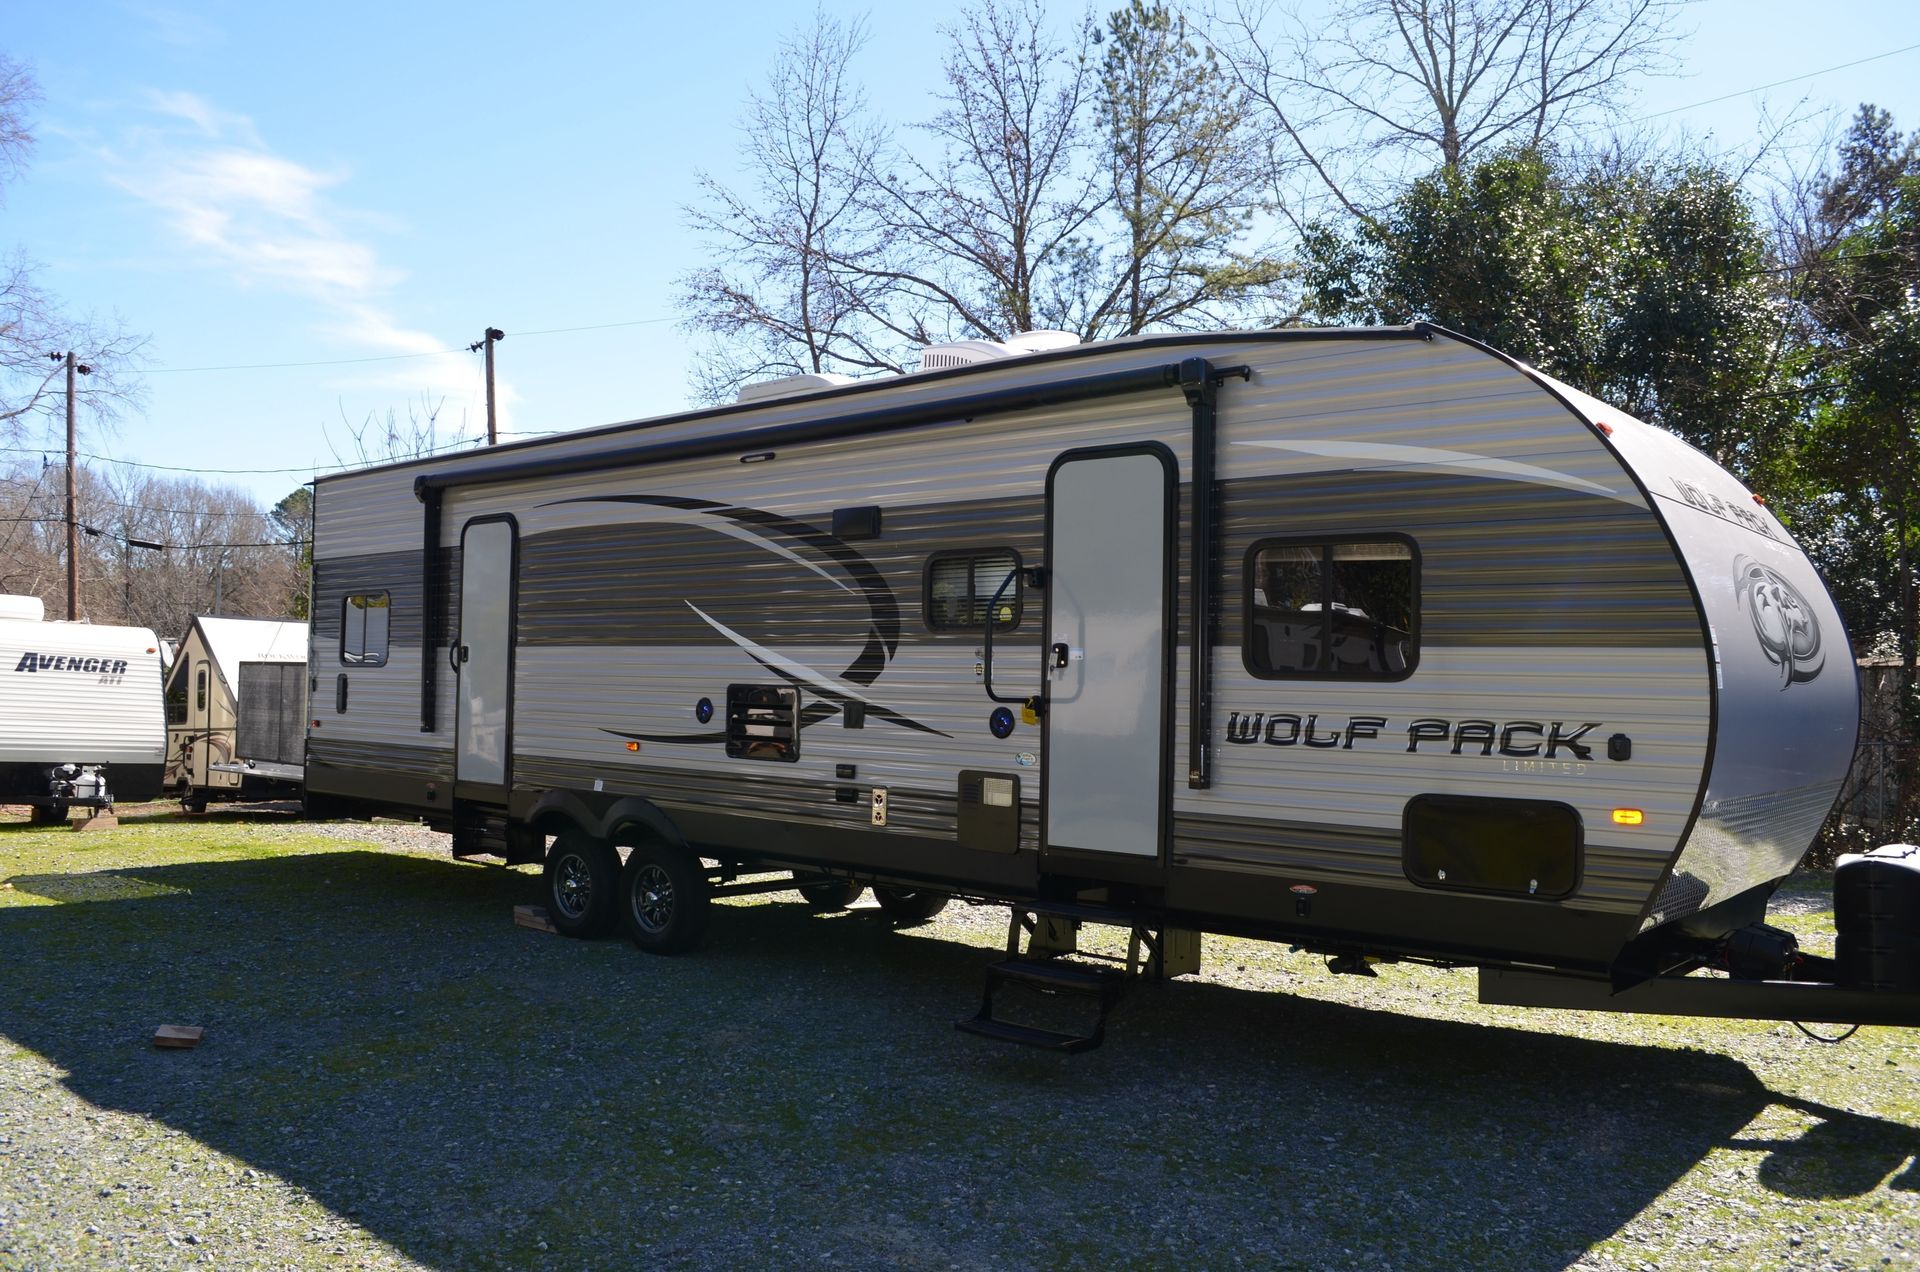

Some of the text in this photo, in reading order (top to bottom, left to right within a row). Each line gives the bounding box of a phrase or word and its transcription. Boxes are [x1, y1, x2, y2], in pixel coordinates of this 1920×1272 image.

[1668, 476, 1780, 540] WOLF PACK
[14, 652, 128, 675] AVENGER
[1226, 711, 1603, 761] WOLF PACK
[1503, 760, 1586, 776] LIMITED
